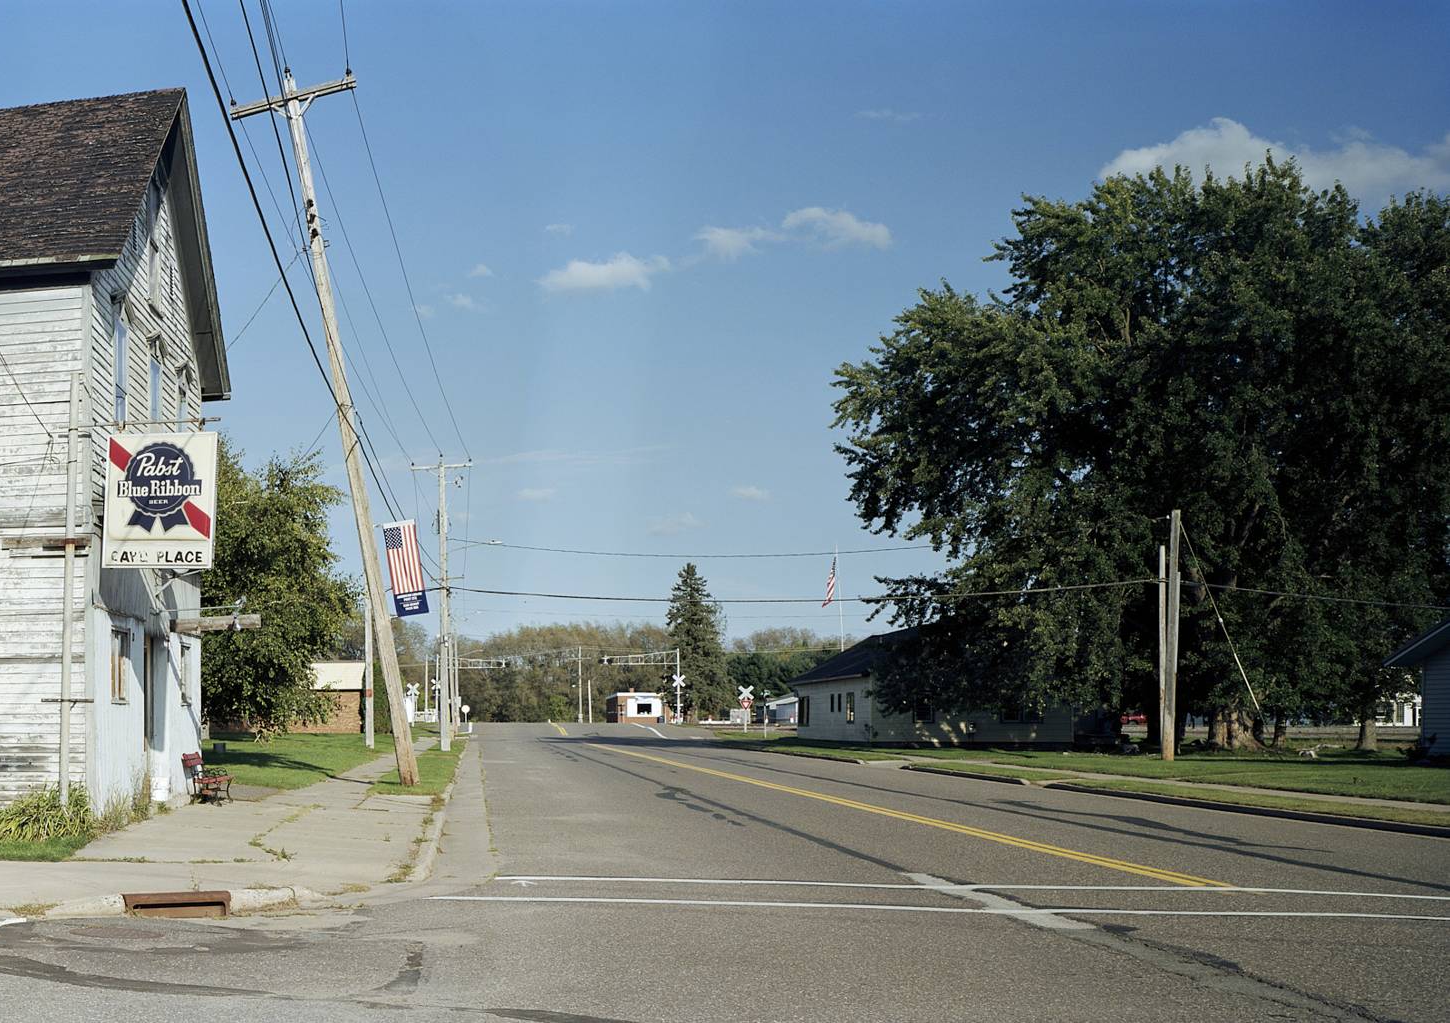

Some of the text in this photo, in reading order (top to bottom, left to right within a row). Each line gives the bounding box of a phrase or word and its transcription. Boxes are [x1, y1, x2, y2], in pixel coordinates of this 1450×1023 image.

[136, 452, 184, 477] Pabst
[118, 479, 201, 497] Blue Ribbon
[156, 550, 203, 563] PLACE
